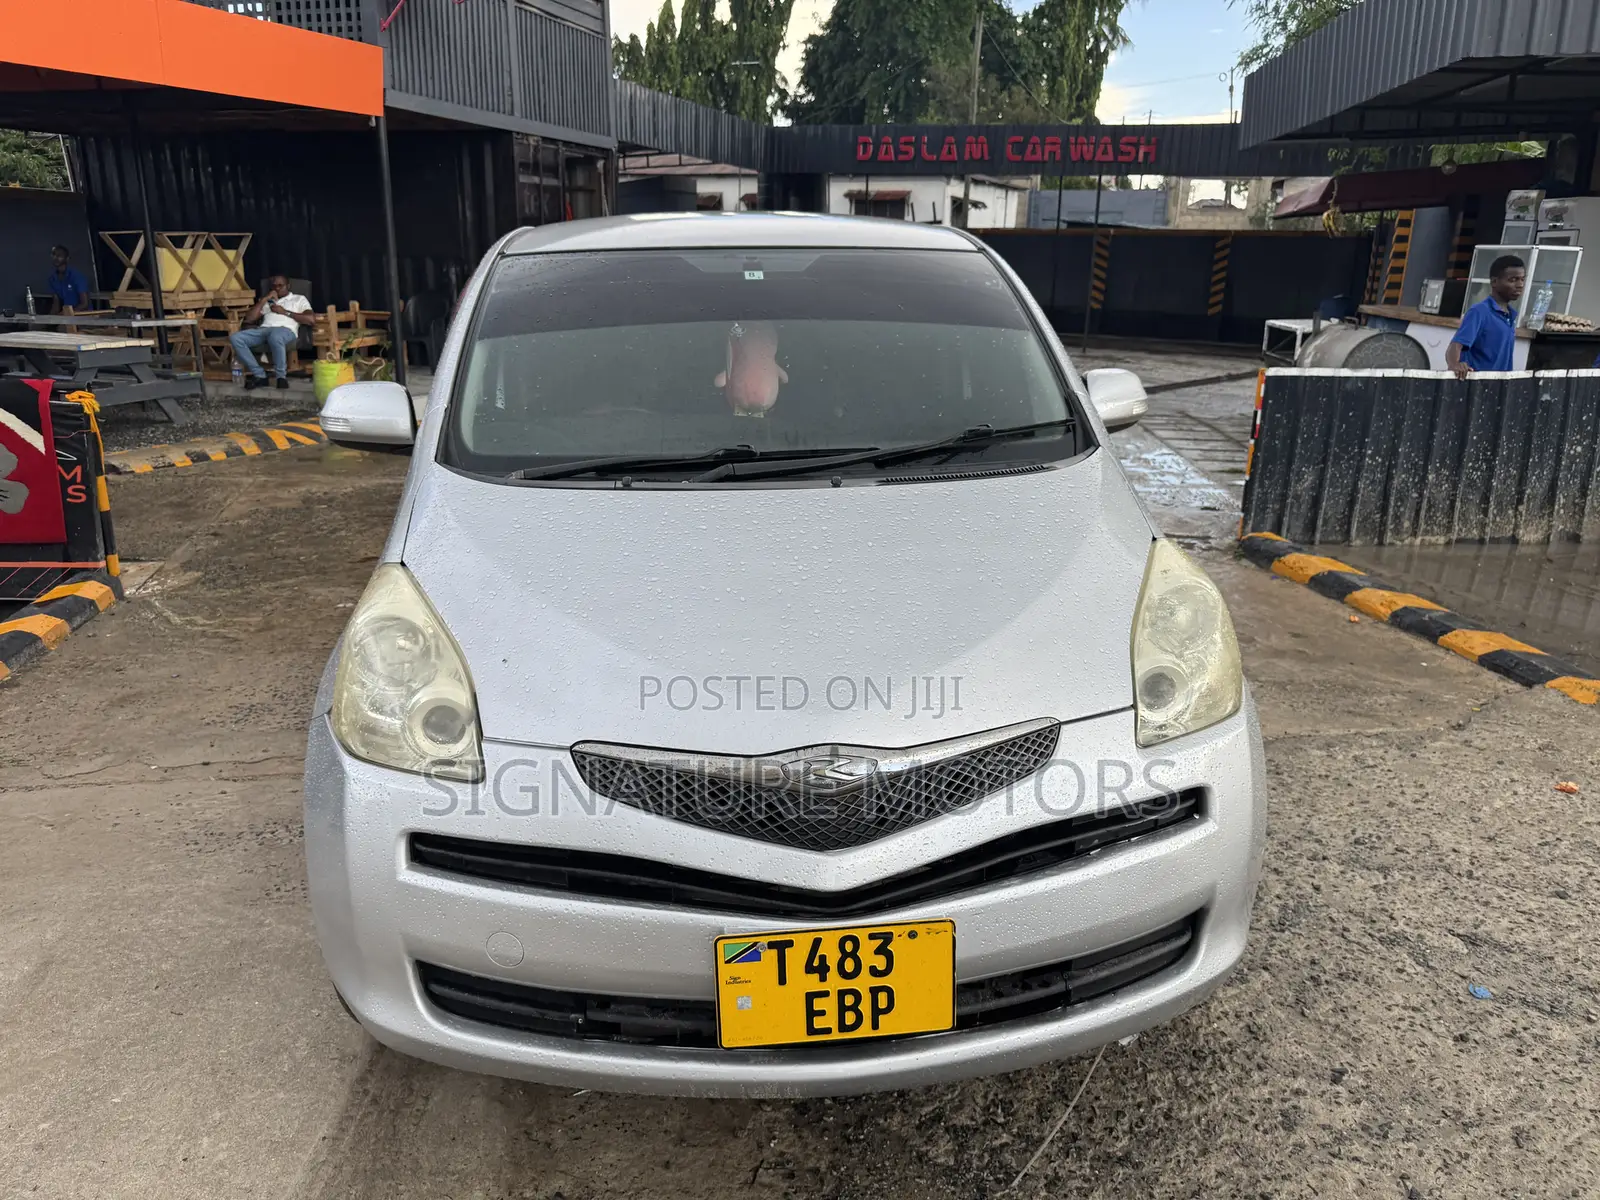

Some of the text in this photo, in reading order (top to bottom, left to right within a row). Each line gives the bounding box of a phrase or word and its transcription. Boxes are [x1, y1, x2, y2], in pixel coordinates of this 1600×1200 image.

[856, 136, 1158, 163] DASLAM CAR WASH
[767, 931, 895, 986] T 483
[805, 984, 896, 1036] EBP
